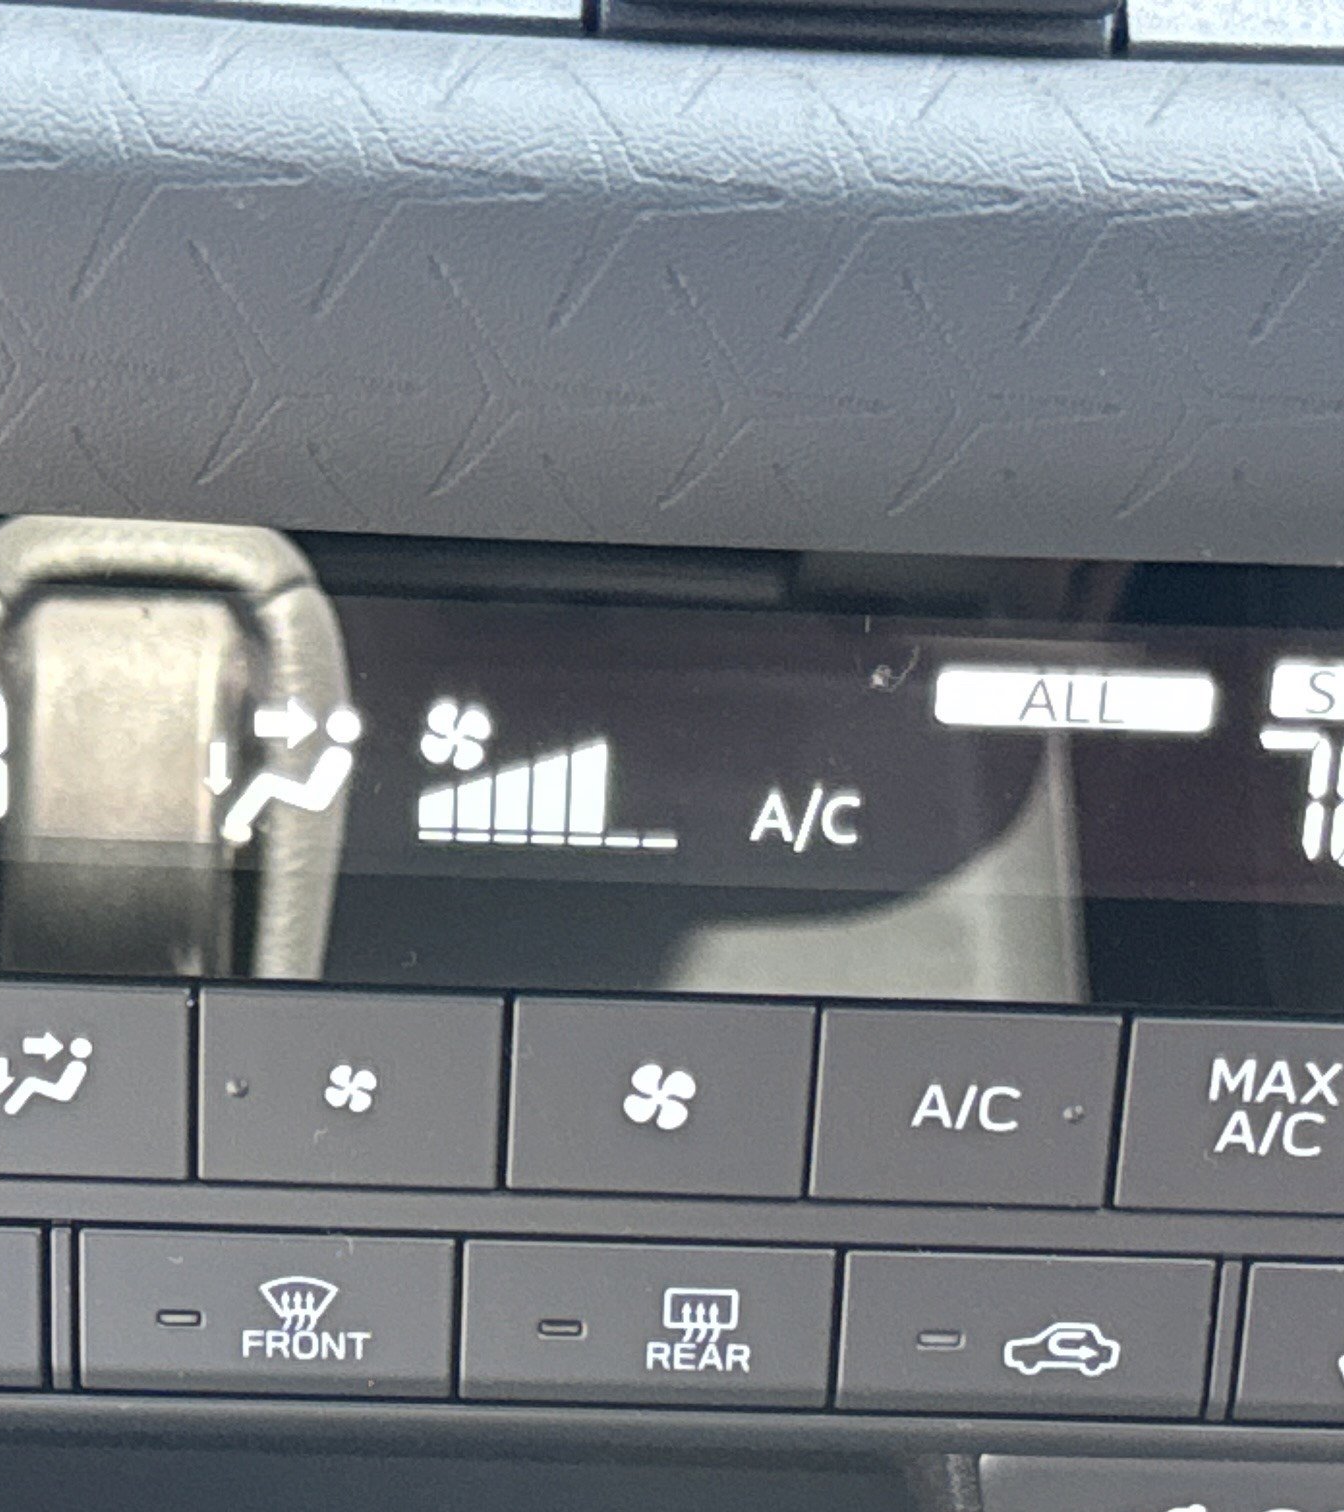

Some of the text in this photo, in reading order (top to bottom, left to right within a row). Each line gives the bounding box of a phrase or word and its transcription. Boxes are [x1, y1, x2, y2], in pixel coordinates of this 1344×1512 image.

[1017, 676, 1127, 727] ALL
[748, 785, 862, 854] A/C
[910, 1082, 1023, 1133] A/C
[1208, 1056, 1344, 1108] MAX
[1213, 1110, 1327, 1158] A/C
[241, 1329, 373, 1362] FRONT
[644, 1342, 752, 1374] REAR
